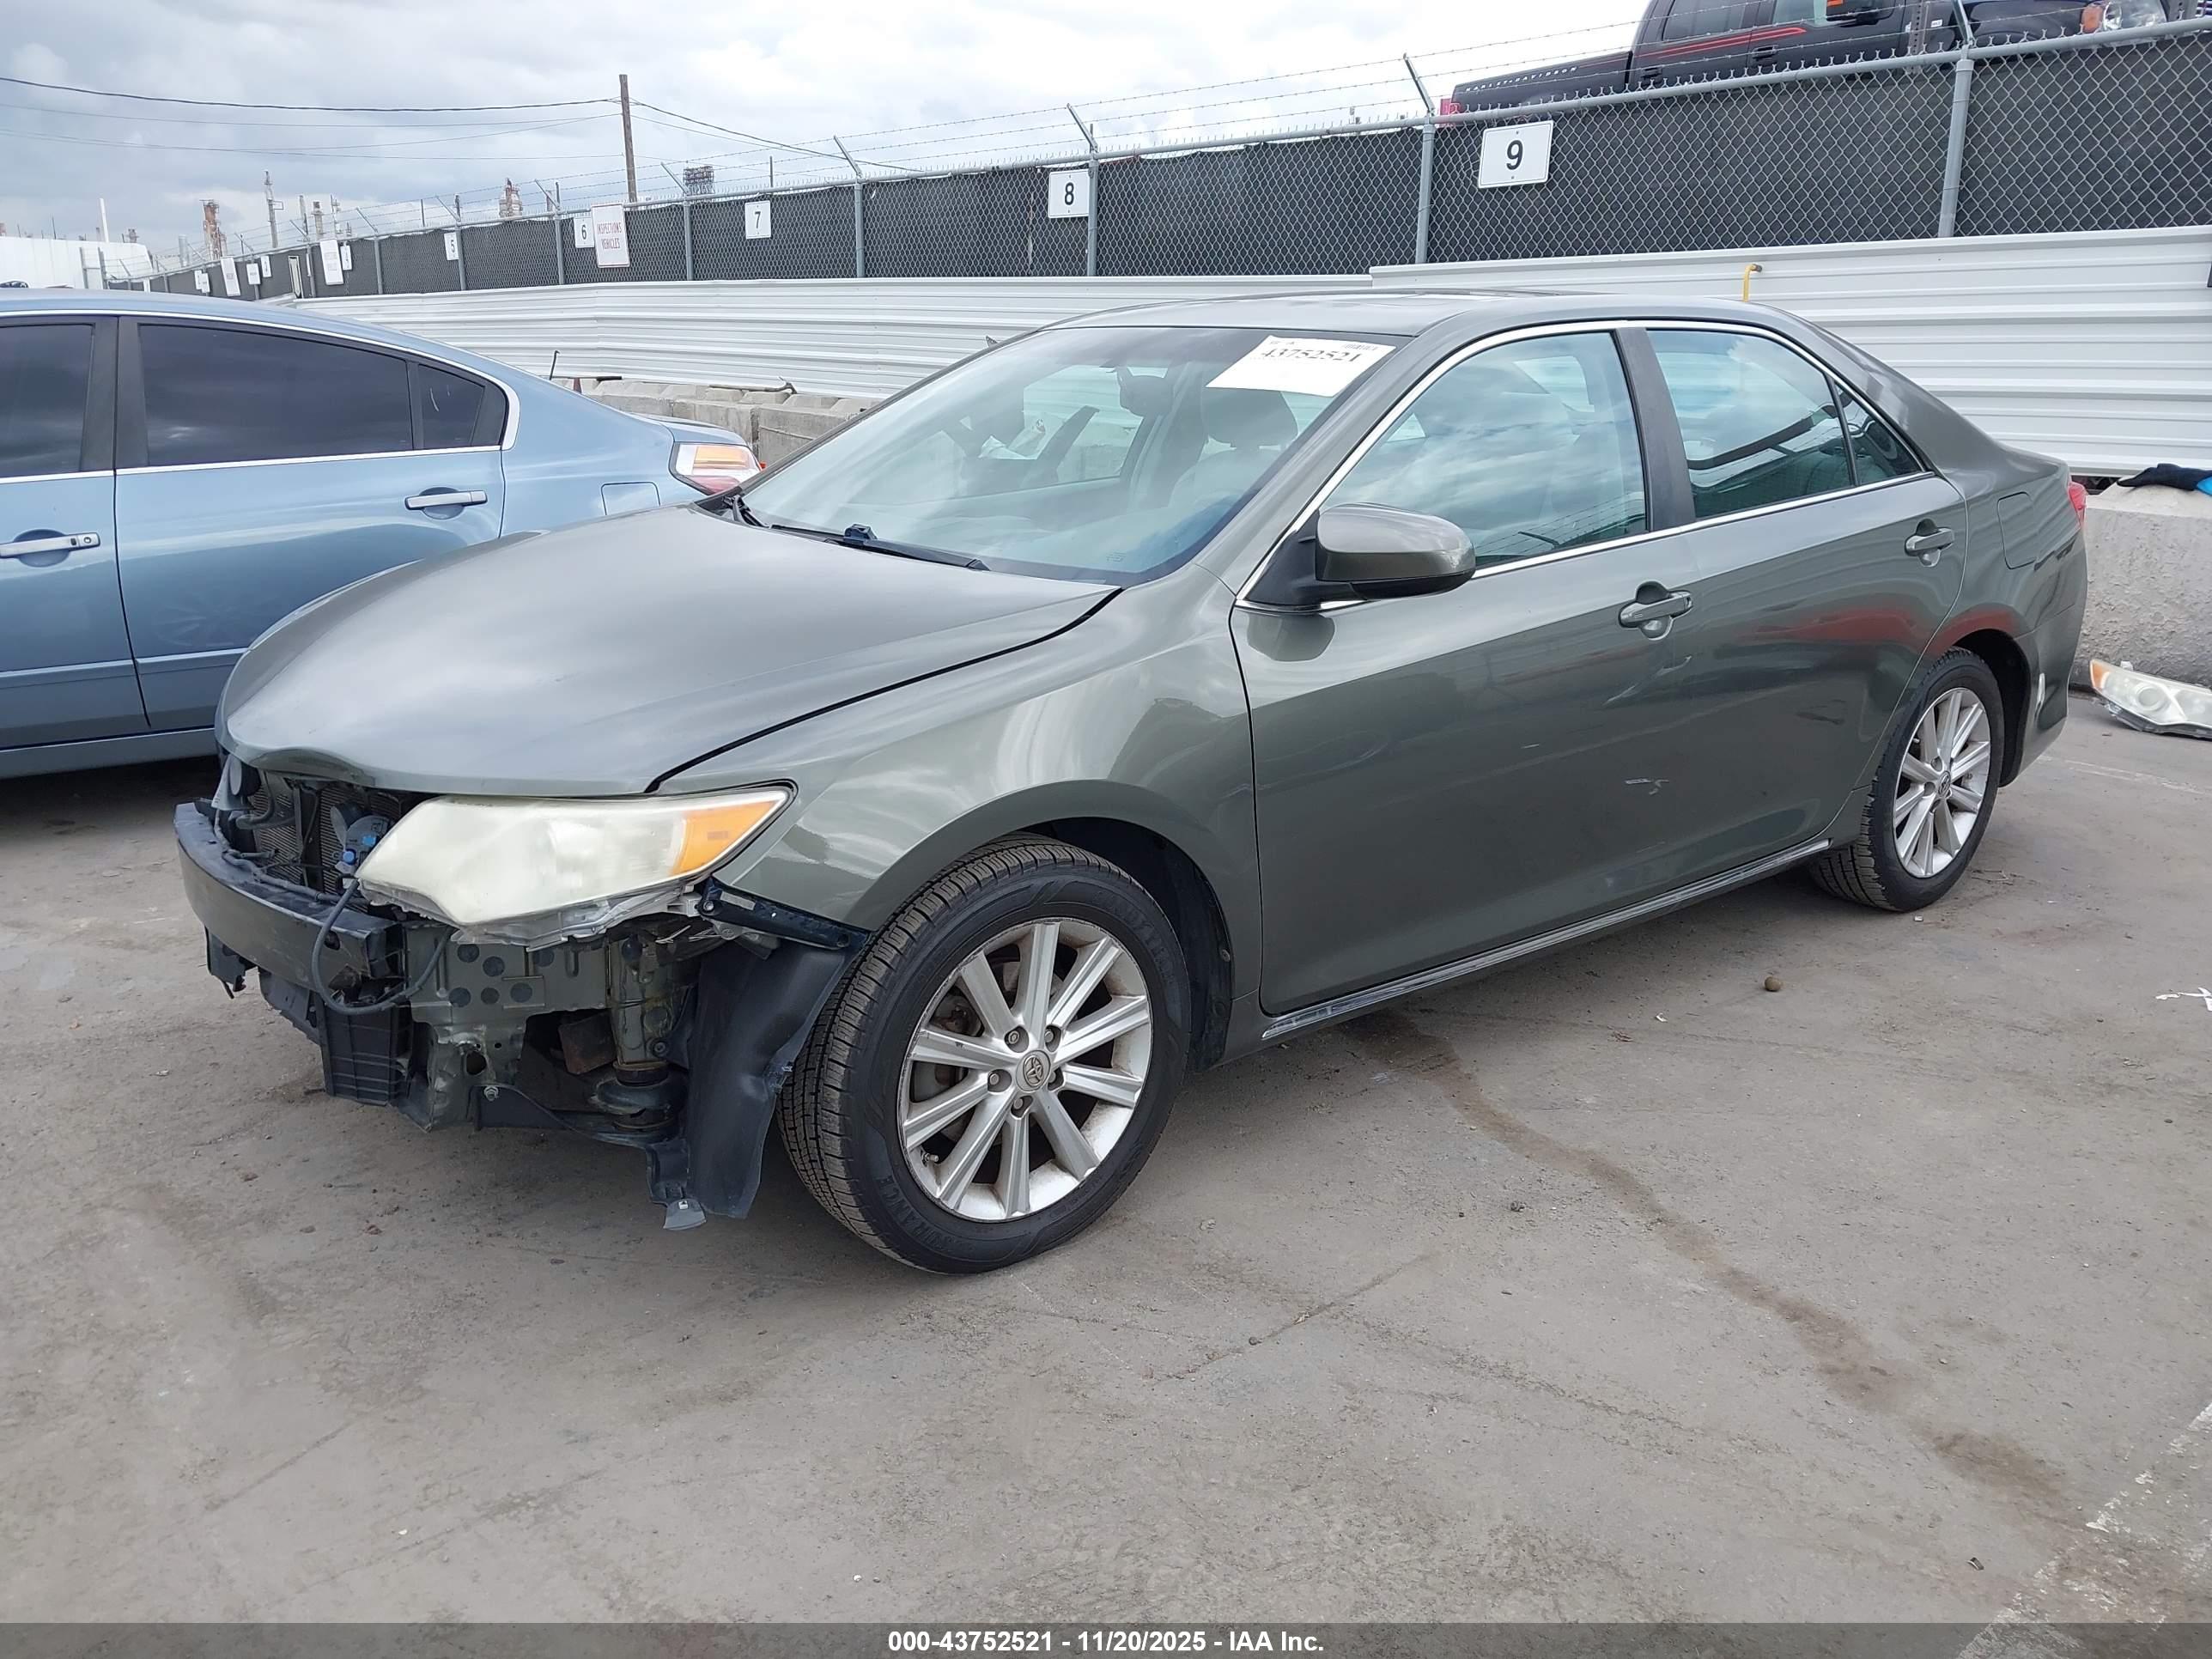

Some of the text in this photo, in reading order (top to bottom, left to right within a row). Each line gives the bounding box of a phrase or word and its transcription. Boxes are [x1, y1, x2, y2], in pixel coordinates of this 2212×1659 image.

[1505, 138, 1523, 170] 9
[1064, 182, 1075, 206] 8
[754, 211, 762, 229] 7
[581, 225, 587, 240] 6
[597, 222, 622, 234] INSPECTIONS
[449, 239, 455, 253] 5
[601, 237, 621, 250] VEHICLES
[1261, 348, 1363, 362] 43752521
